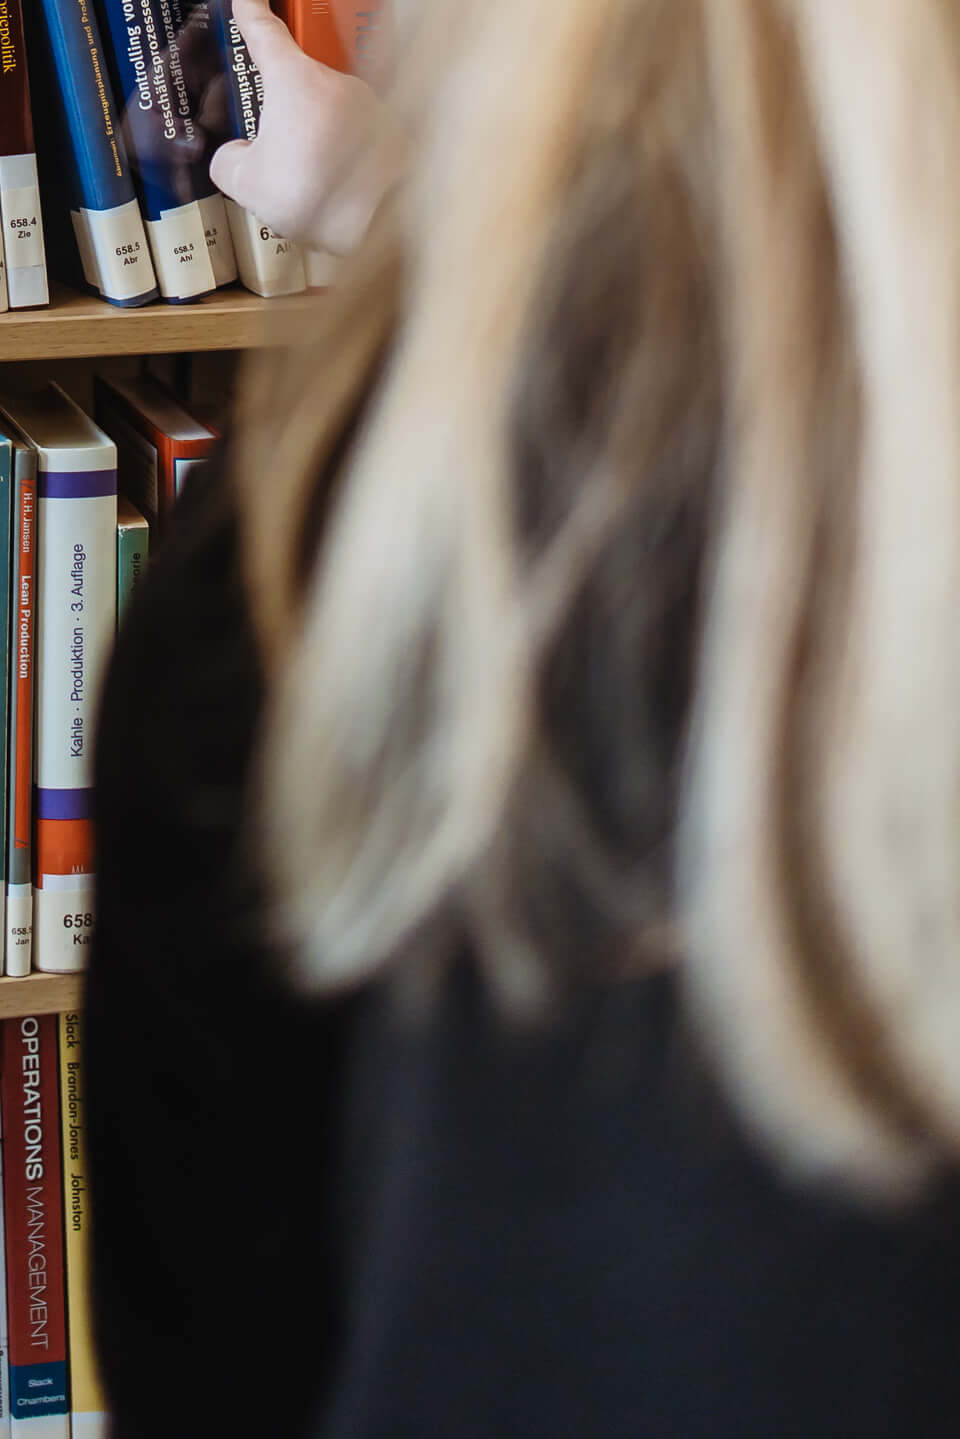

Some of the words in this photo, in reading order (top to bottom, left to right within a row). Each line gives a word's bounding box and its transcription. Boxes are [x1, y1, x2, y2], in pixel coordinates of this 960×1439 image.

[84, 26, 95, 46] und
[127, 24, 153, 111] Controlling
[90, 48, 113, 137] Erzeugnisplanung
[185, 117, 196, 143] von
[10, 216, 37, 229] 658.4
[115, 241, 141, 257] 658.5
[123, 256, 139, 266] Abr
[173, 243, 195, 255] 658.5
[71, 543, 86, 596] Auflage
[20, 575, 32, 606] Lean
[71, 599, 84, 612] 3.
[19, 609, 31, 679] Production
[71, 627, 84, 702] Produktion
[71, 717, 83, 758] Kahle
[65, 1013, 79, 1049] Slack
[20, 1017, 44, 1182] OPERATIONS
[66, 1062, 81, 1161] Brandon-Jones
[70, 1173, 86, 1232] Johnston
[25, 1186, 49, 1352] MANAGEMENT
[16, 1395, 66, 1408] Chambers
